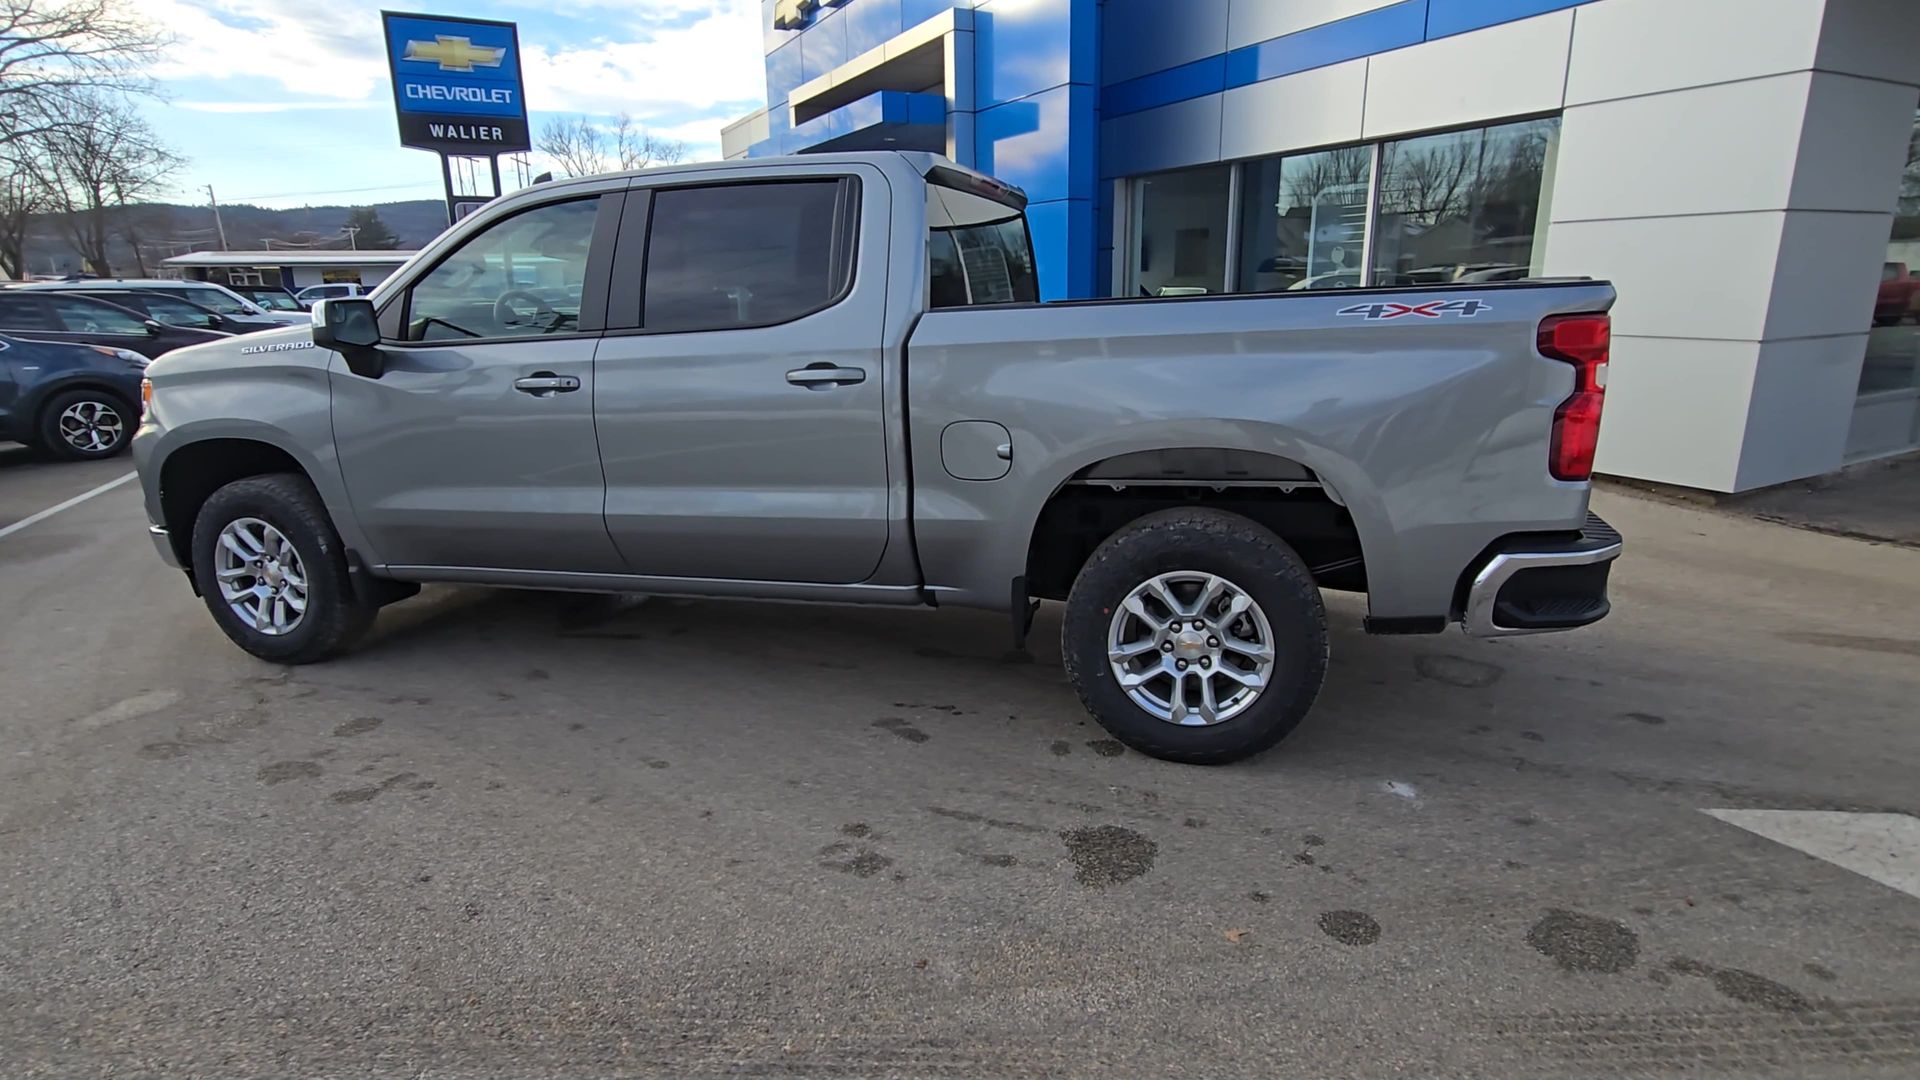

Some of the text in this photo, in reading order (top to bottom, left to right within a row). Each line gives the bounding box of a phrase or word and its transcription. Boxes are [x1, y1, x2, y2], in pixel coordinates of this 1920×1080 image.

[405, 83, 513, 104] CHEVROLET
[429, 123, 503, 141] WALIER
[241, 341, 315, 354] SILVERADO
